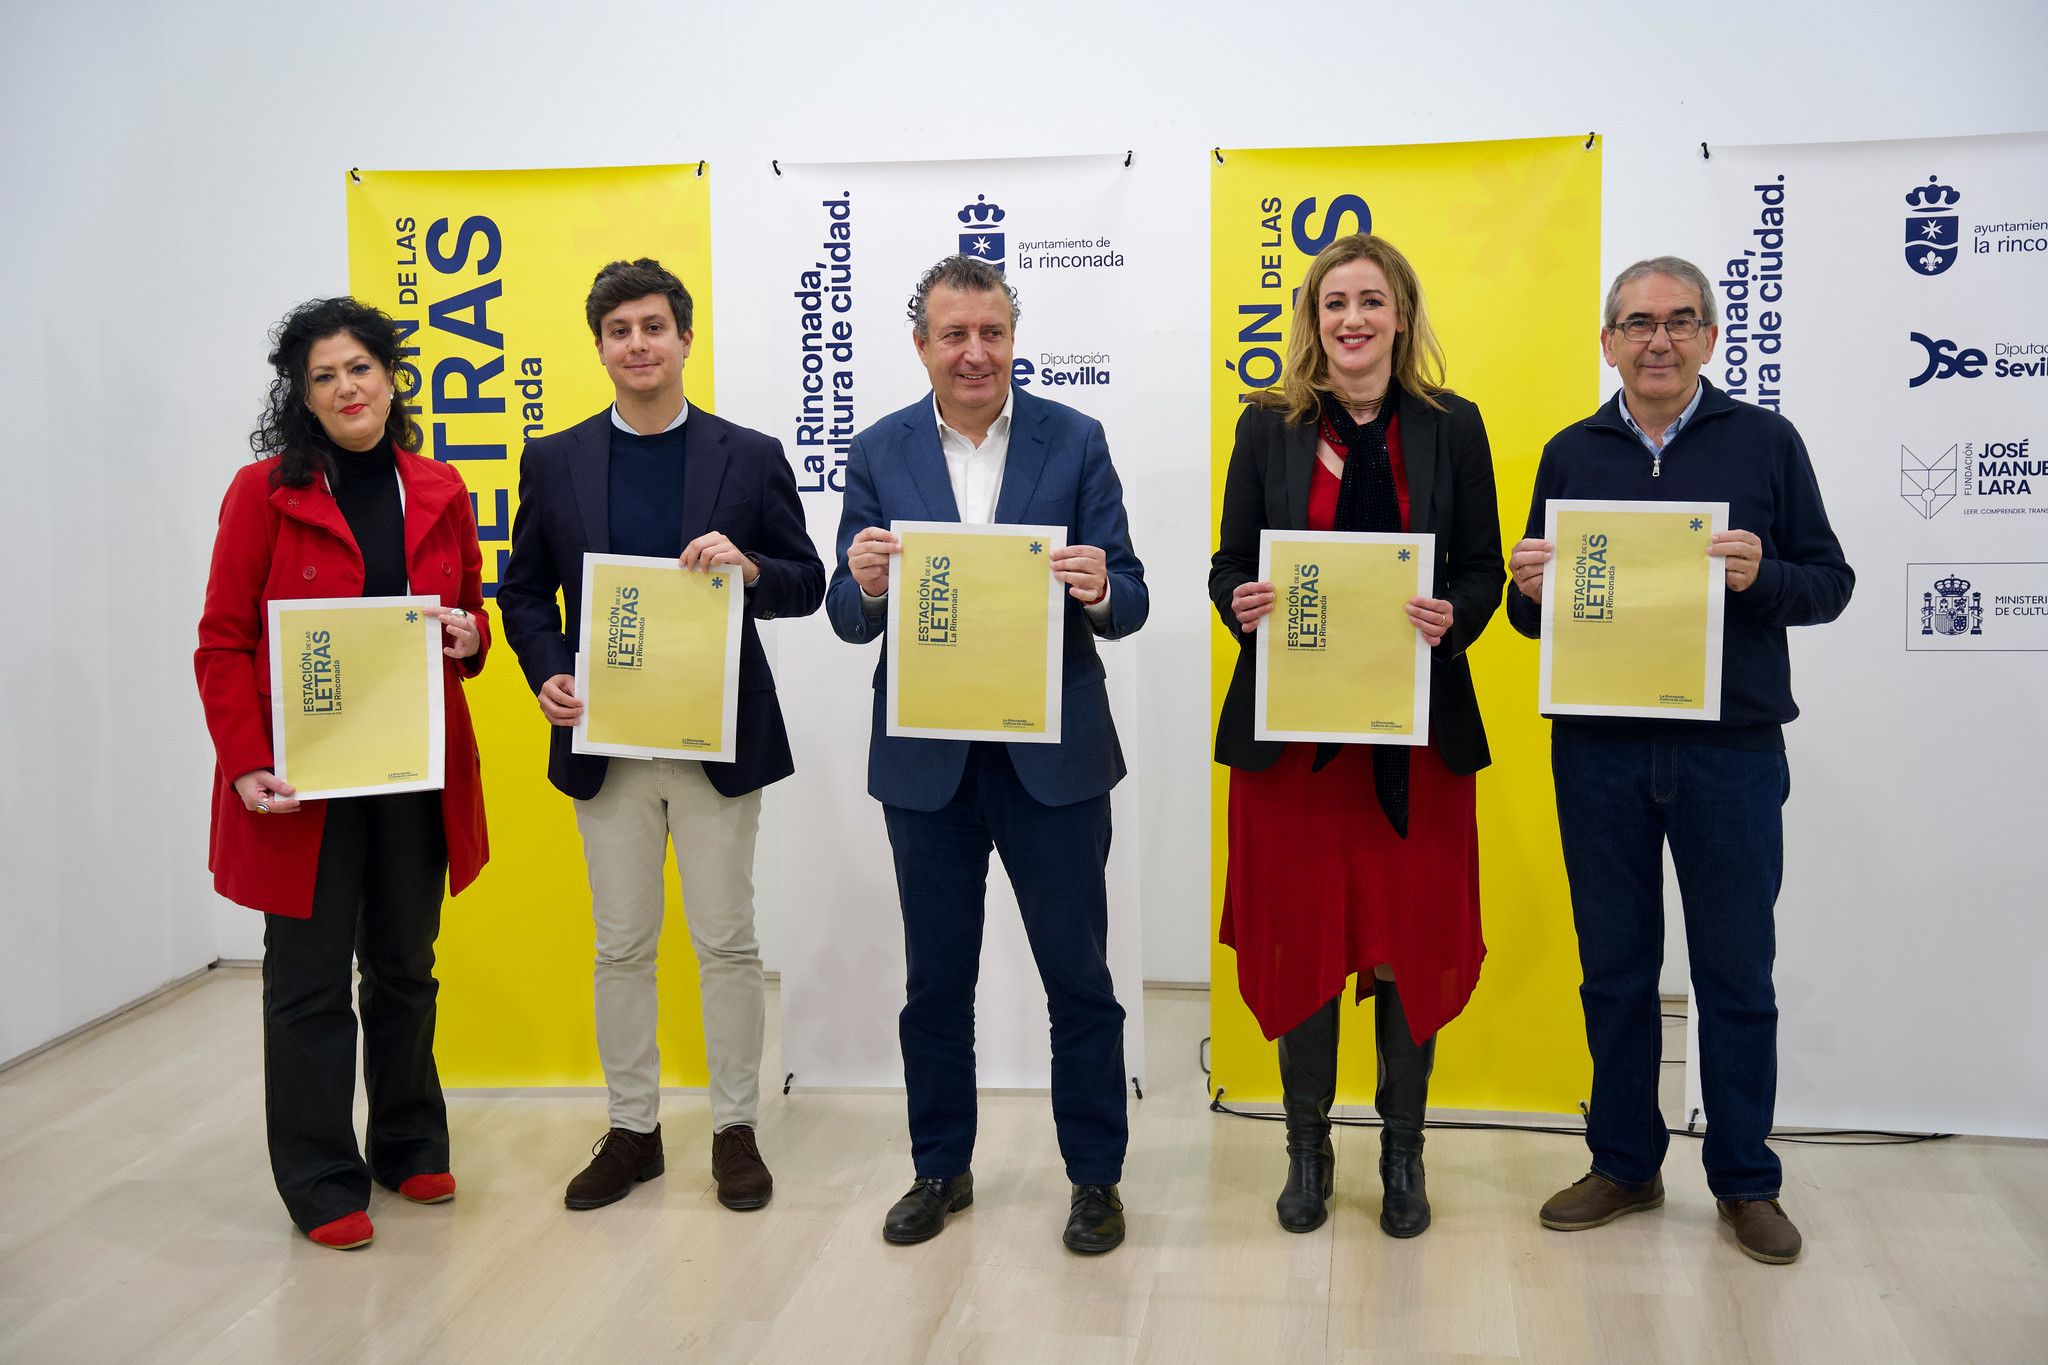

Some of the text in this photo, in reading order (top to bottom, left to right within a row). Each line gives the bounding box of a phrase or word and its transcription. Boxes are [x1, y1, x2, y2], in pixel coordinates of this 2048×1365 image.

[396, 217, 416, 265] LAS
[1018, 237, 1111, 251] ayuntamiento de
[1018, 251, 1124, 269] la rinconada
[1261, 197, 1282, 288] DE LAS
[1752, 174, 1785, 302] ciudad.
[1974, 235, 2048, 254] la rinco
[398, 272, 418, 304] DE
[822, 190, 854, 492] Cultura de ciudad.
[1040, 352, 1110, 367] Diputación
[1751, 311, 1782, 354] de
[794, 262, 827, 492] La Rinconada,
[1041, 366, 1110, 386] Sevilla
[1995, 357, 2048, 378] Sevi
[1963, 442, 1973, 496] FUNDACIÓN
[1978, 438, 2029, 458] JOSÉ
[1978, 479, 2031, 495] LARA
[930, 556, 951, 643] LETRAS
[1573, 556, 1587, 618] ESTACIÓN
[1585, 534, 1608, 619] LETRAS
[1606, 565, 1615, 620] La Rinconada
[1995, 595, 2048, 604] MINISTERI
[618, 587, 639, 667] LETRAS
[917, 578, 930, 642] ESTACIÓN
[949, 588, 958, 643] La Rinconada
[1286, 586, 1300, 647] ESTACIÓN
[1300, 564, 1319, 648] LETRAS
[1319, 595, 1327, 648] La Rinconada
[1995, 606, 2048, 616] DE CULTU
[607, 606, 620, 665] ESTACIÓN
[635, 617, 645, 667] La Rinconada
[299, 652, 314, 713] ESTACIÓN
[312, 630, 334, 712] LETRAS
[333, 660, 342, 711] La Rinconada
